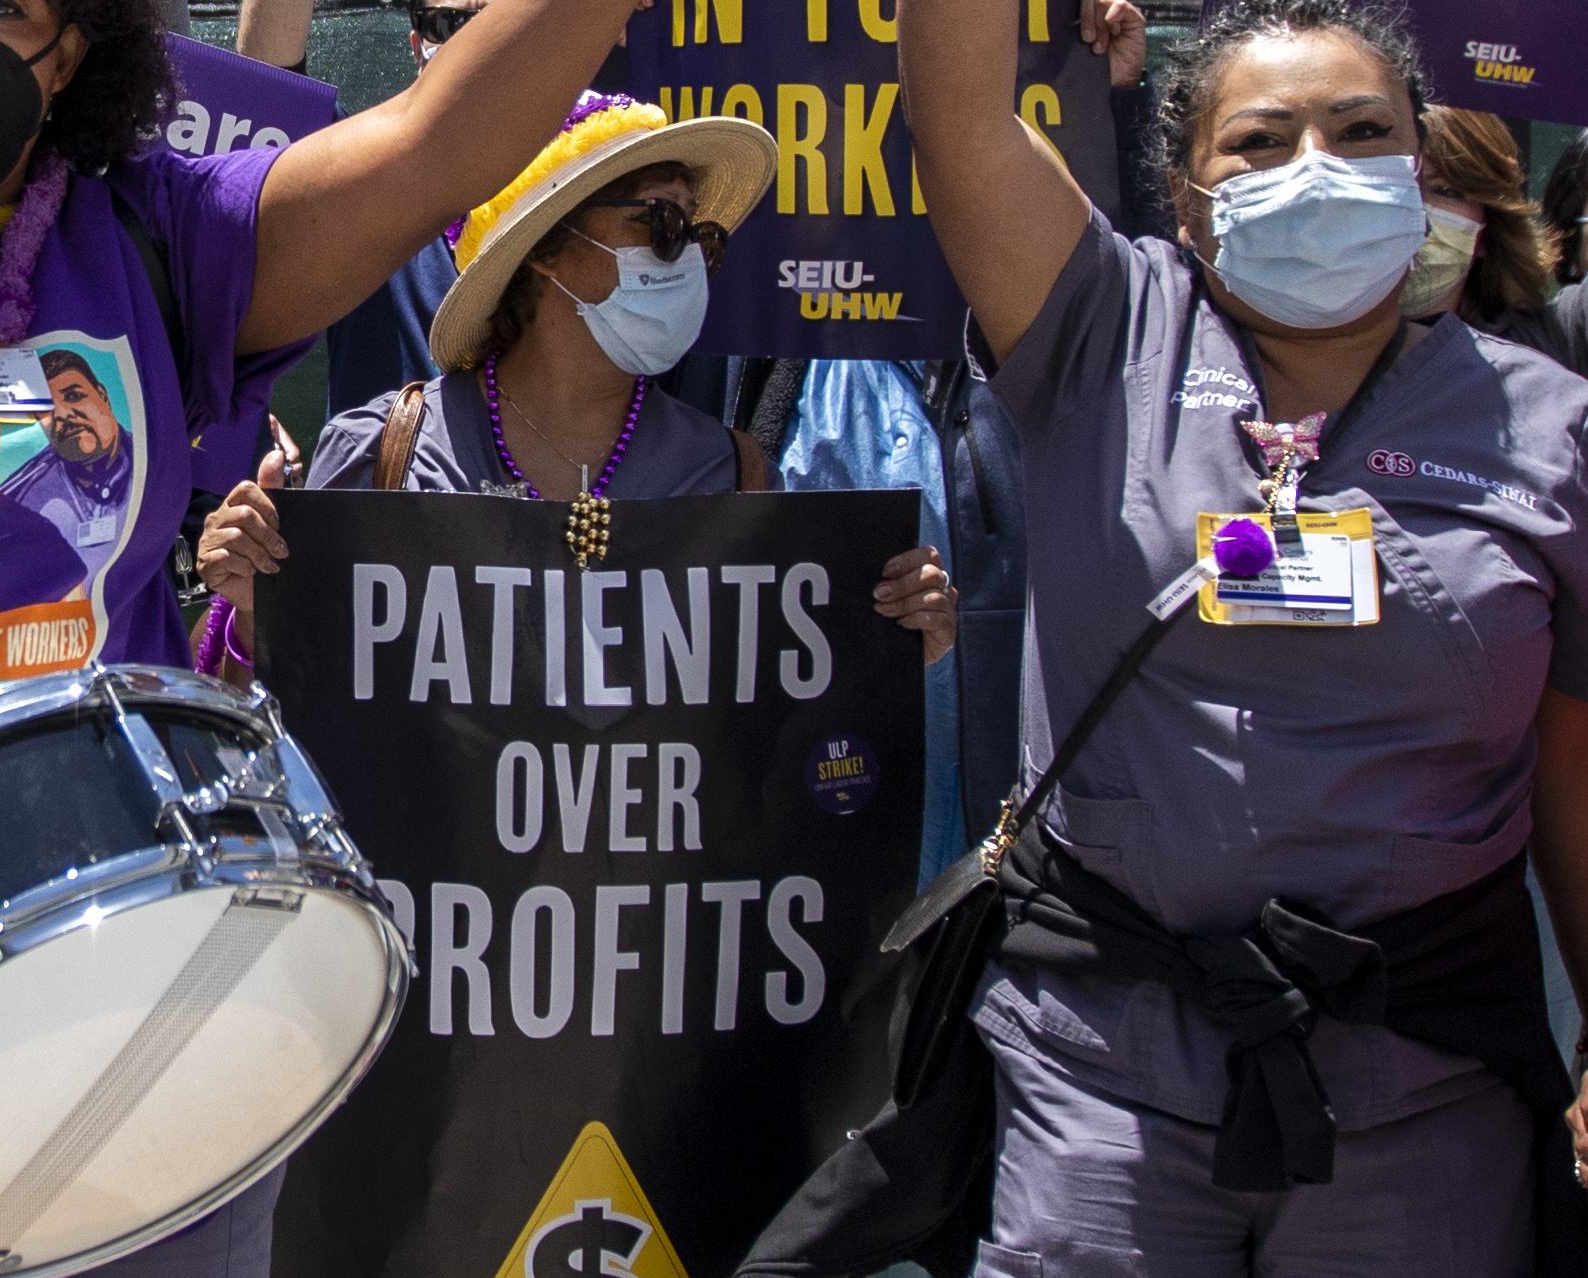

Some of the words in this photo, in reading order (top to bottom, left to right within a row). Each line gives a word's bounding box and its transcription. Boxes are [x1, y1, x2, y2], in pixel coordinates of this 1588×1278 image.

[1464, 41, 1522, 63] SEIU-
[1475, 60, 1536, 84] UHW
[777, 259, 875, 289] SEIU-
[800, 292, 903, 321] UHW
[1169, 390, 1251, 413] Partner
[1420, 461, 1537, 511] CEDARS-SINAI
[1242, 583, 1280, 593] Morales
[6, 616, 89, 667] WORKERS
[352, 562, 833, 708] PATIENTS
[828, 740, 849, 759] ULP
[818, 756, 864, 780] STRIKE!
[495, 740, 703, 854] OVER
